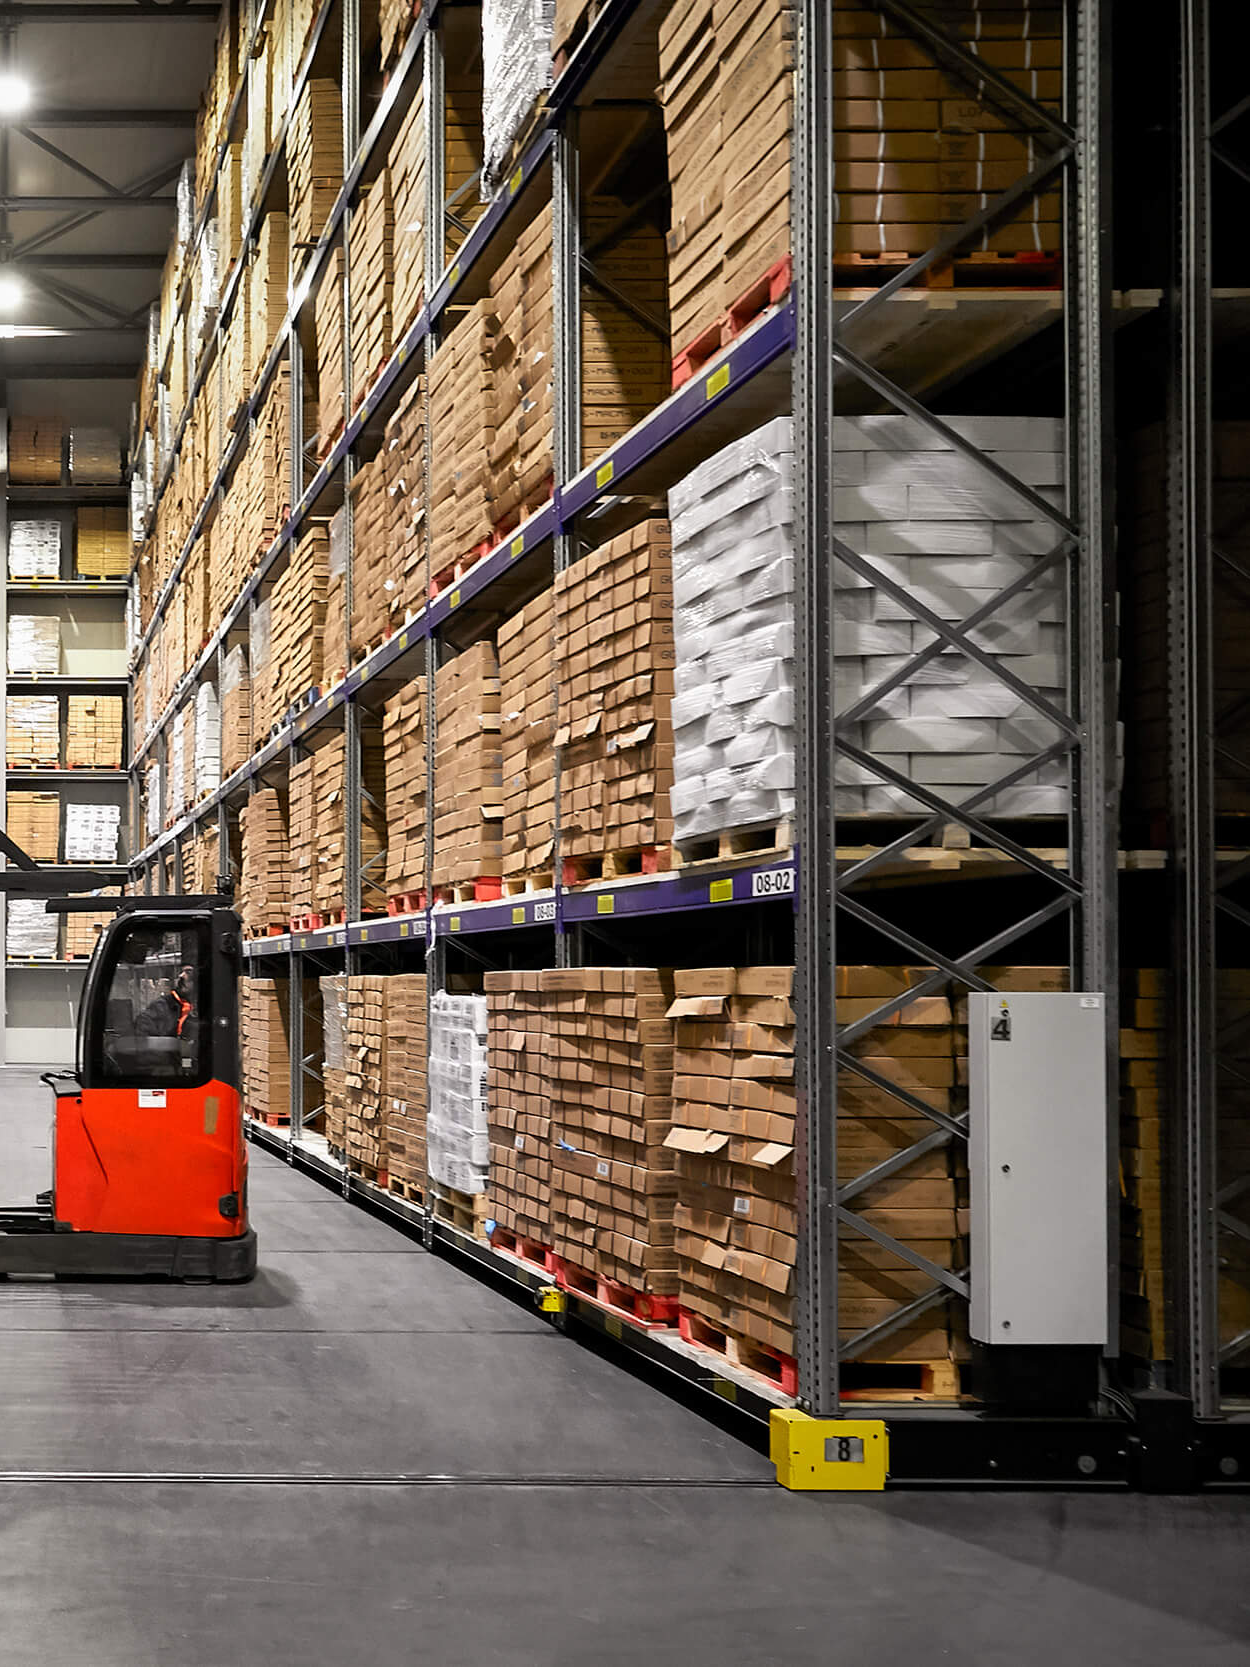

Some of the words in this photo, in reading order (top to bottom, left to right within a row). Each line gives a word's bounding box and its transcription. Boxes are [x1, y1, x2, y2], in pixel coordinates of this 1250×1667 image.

[756, 871, 791, 894] 08-02
[993, 1019, 1010, 1039] 4
[838, 1437, 851, 1462] 8
